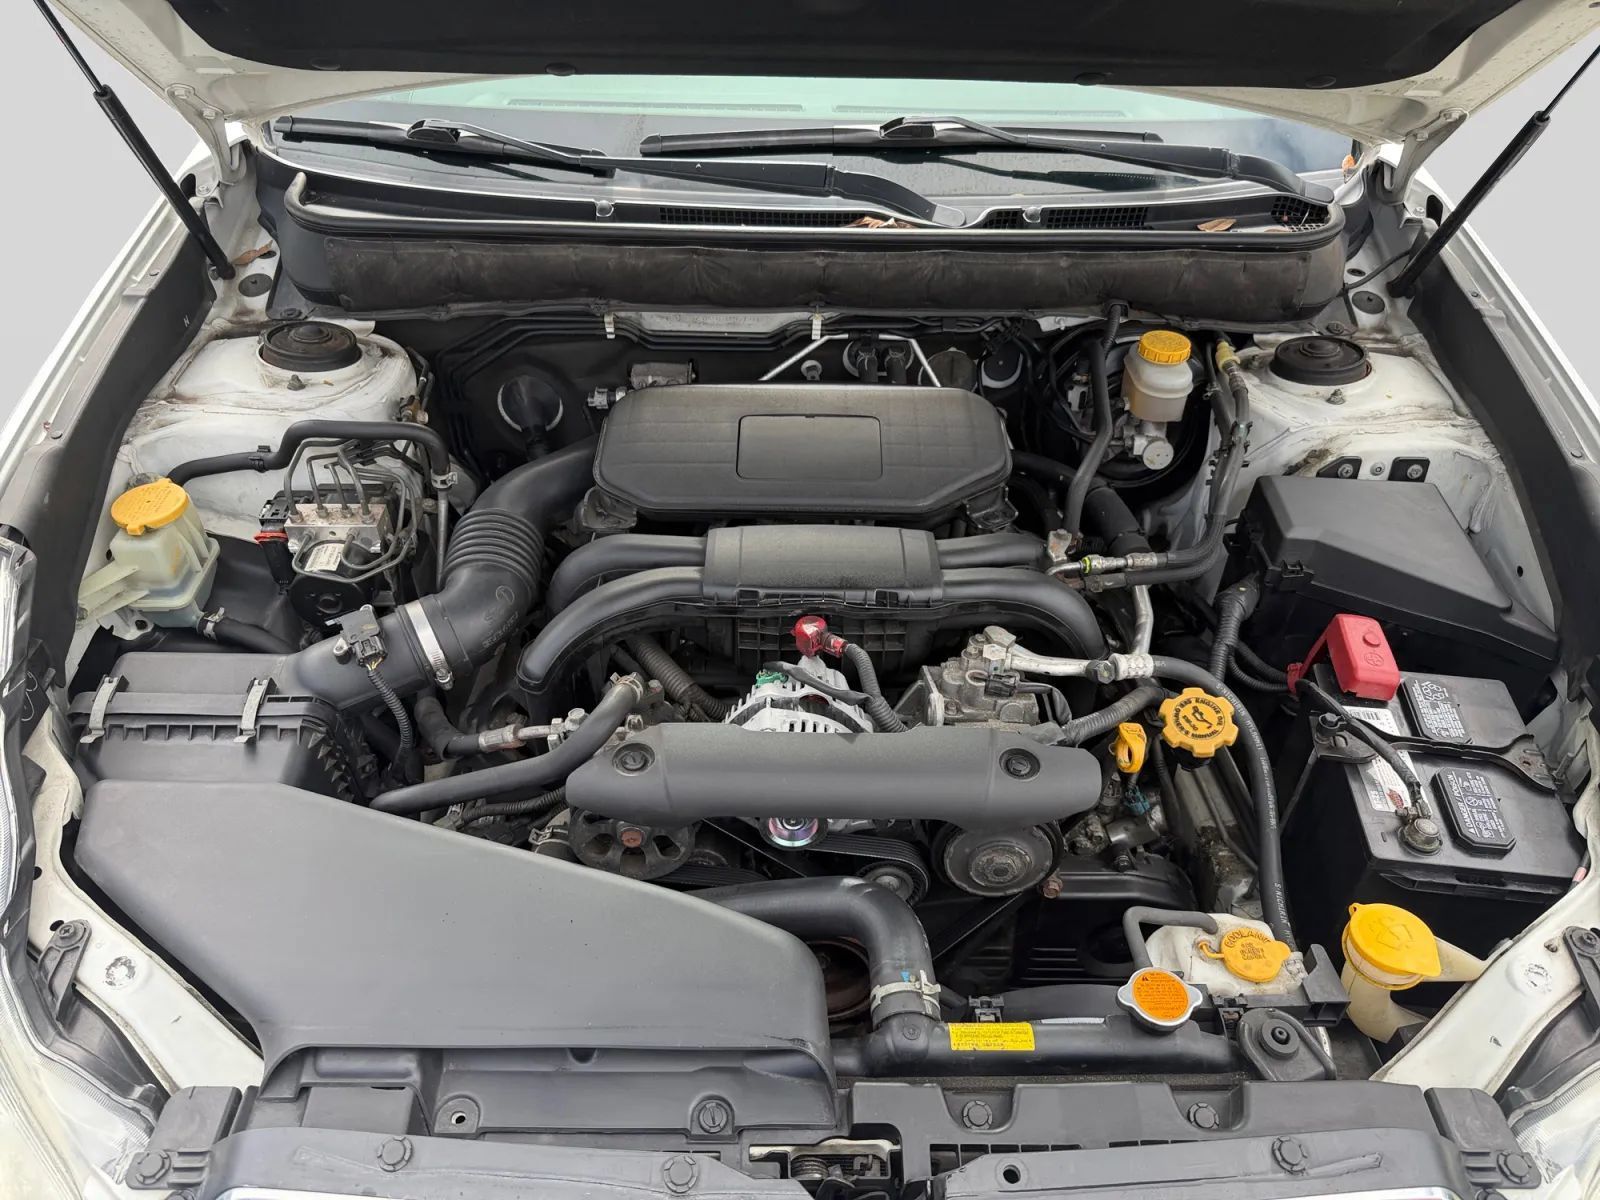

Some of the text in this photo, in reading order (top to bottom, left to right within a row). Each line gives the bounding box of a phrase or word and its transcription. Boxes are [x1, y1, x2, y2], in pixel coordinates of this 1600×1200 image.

[1195, 697, 1221, 714] ENGINE
[1447, 774, 1460, 797] POISON
[1458, 802, 1473, 828] DANGER
[1224, 930, 1271, 948] COOLANT
